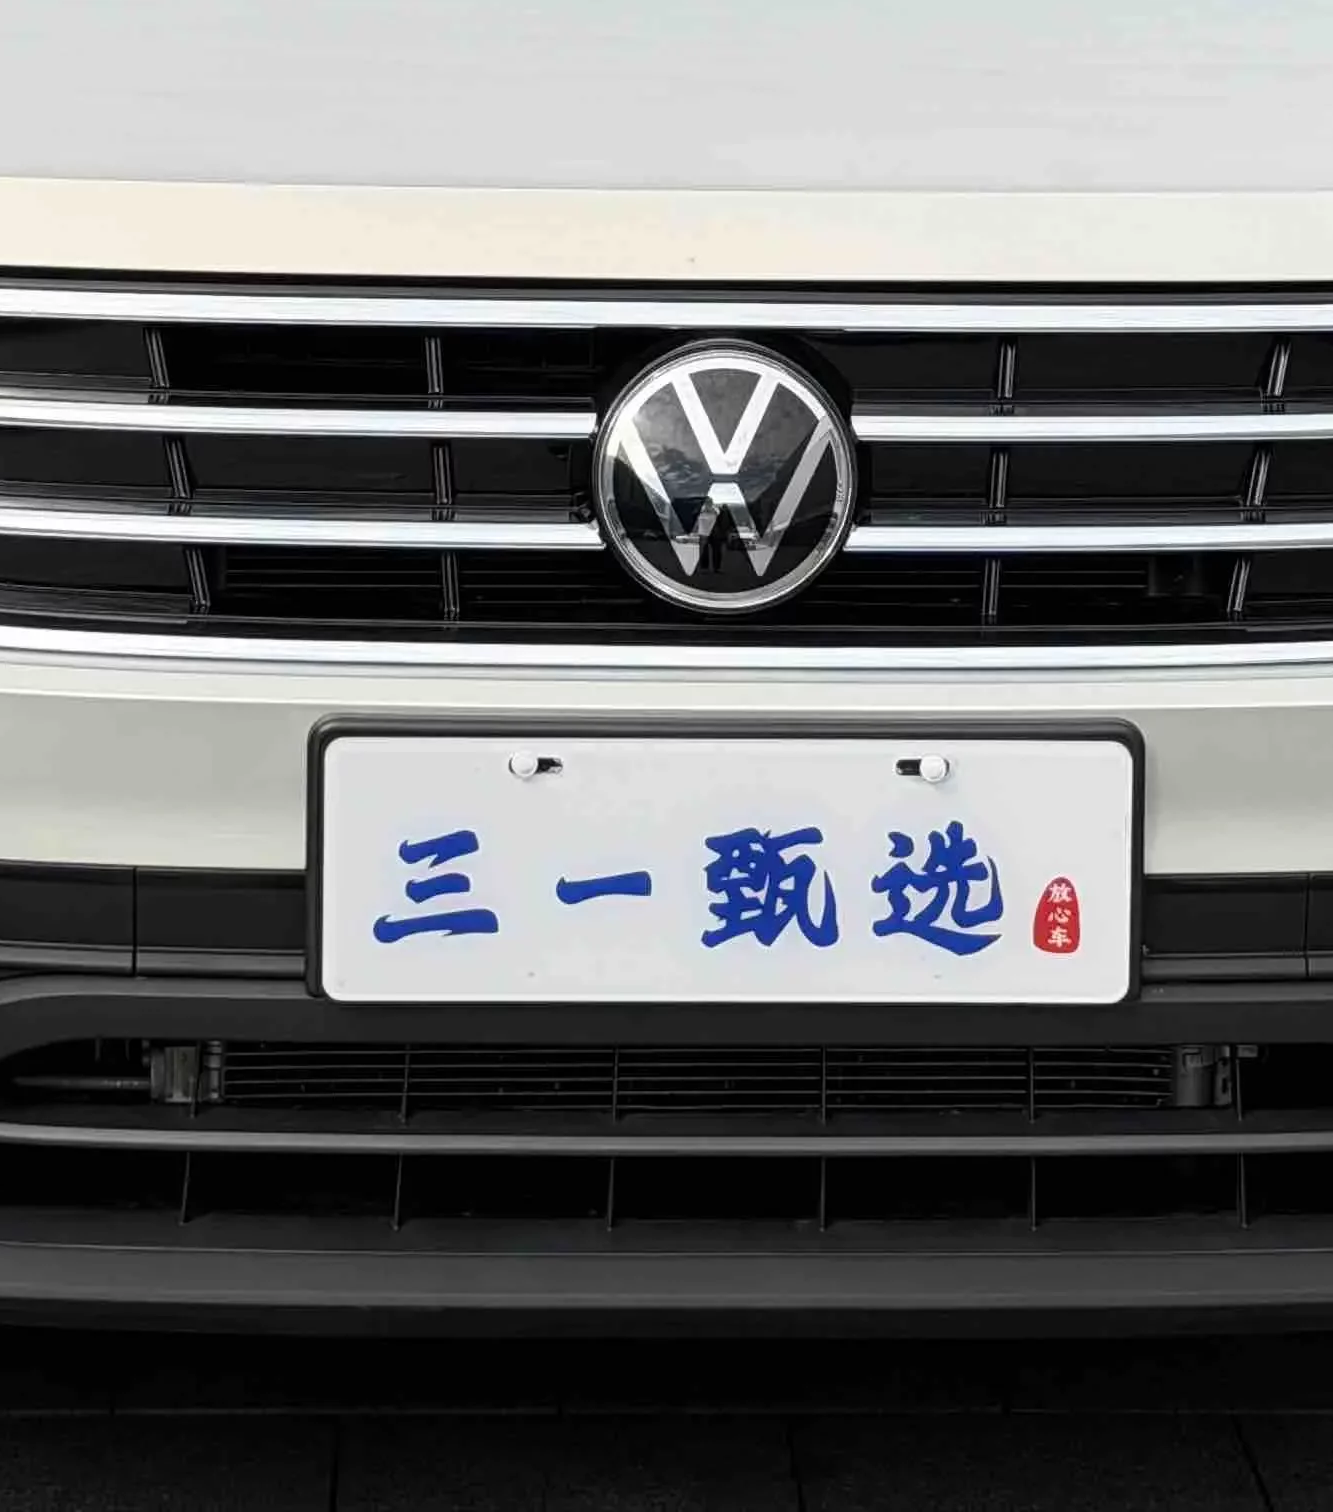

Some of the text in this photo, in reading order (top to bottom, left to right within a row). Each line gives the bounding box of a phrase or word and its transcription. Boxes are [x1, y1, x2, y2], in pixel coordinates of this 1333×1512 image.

[372, 820, 1005, 956] 三一甄选
[1046, 882, 1073, 949] 放心车
